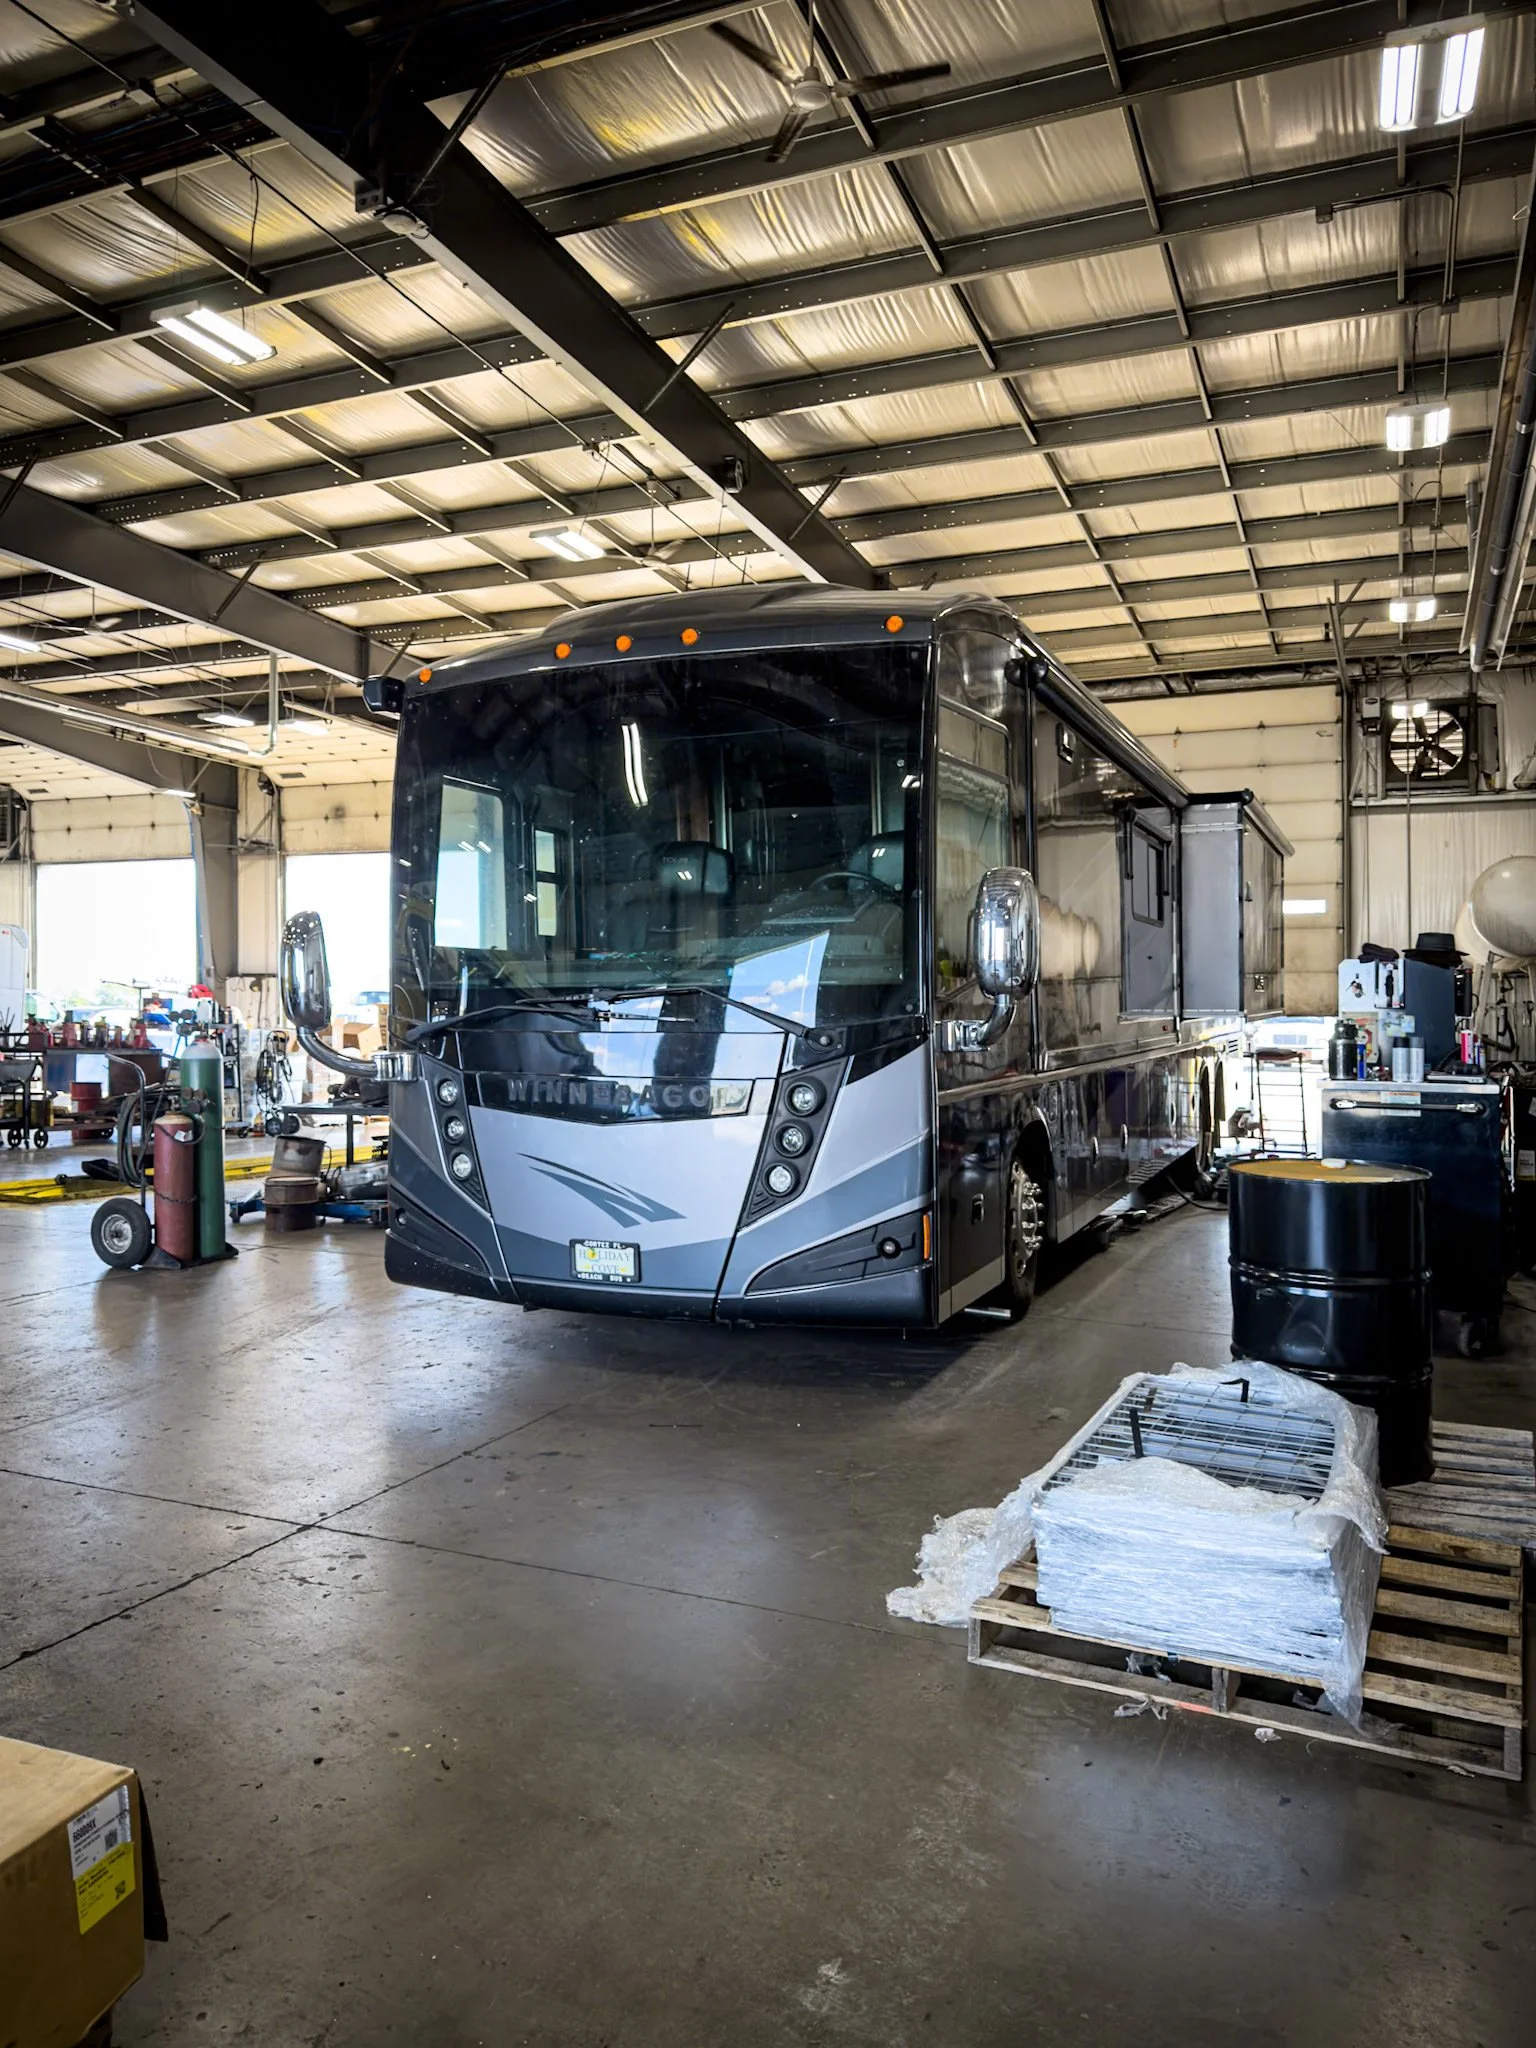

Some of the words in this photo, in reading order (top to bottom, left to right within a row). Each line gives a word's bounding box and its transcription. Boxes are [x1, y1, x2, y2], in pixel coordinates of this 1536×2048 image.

[508, 1079, 710, 1108] WINNEBAGO
[584, 1240, 609, 1248] CORTEZ
[578, 1248, 630, 1261] HOLIDAY
[591, 1264, 619, 1274] COVE
